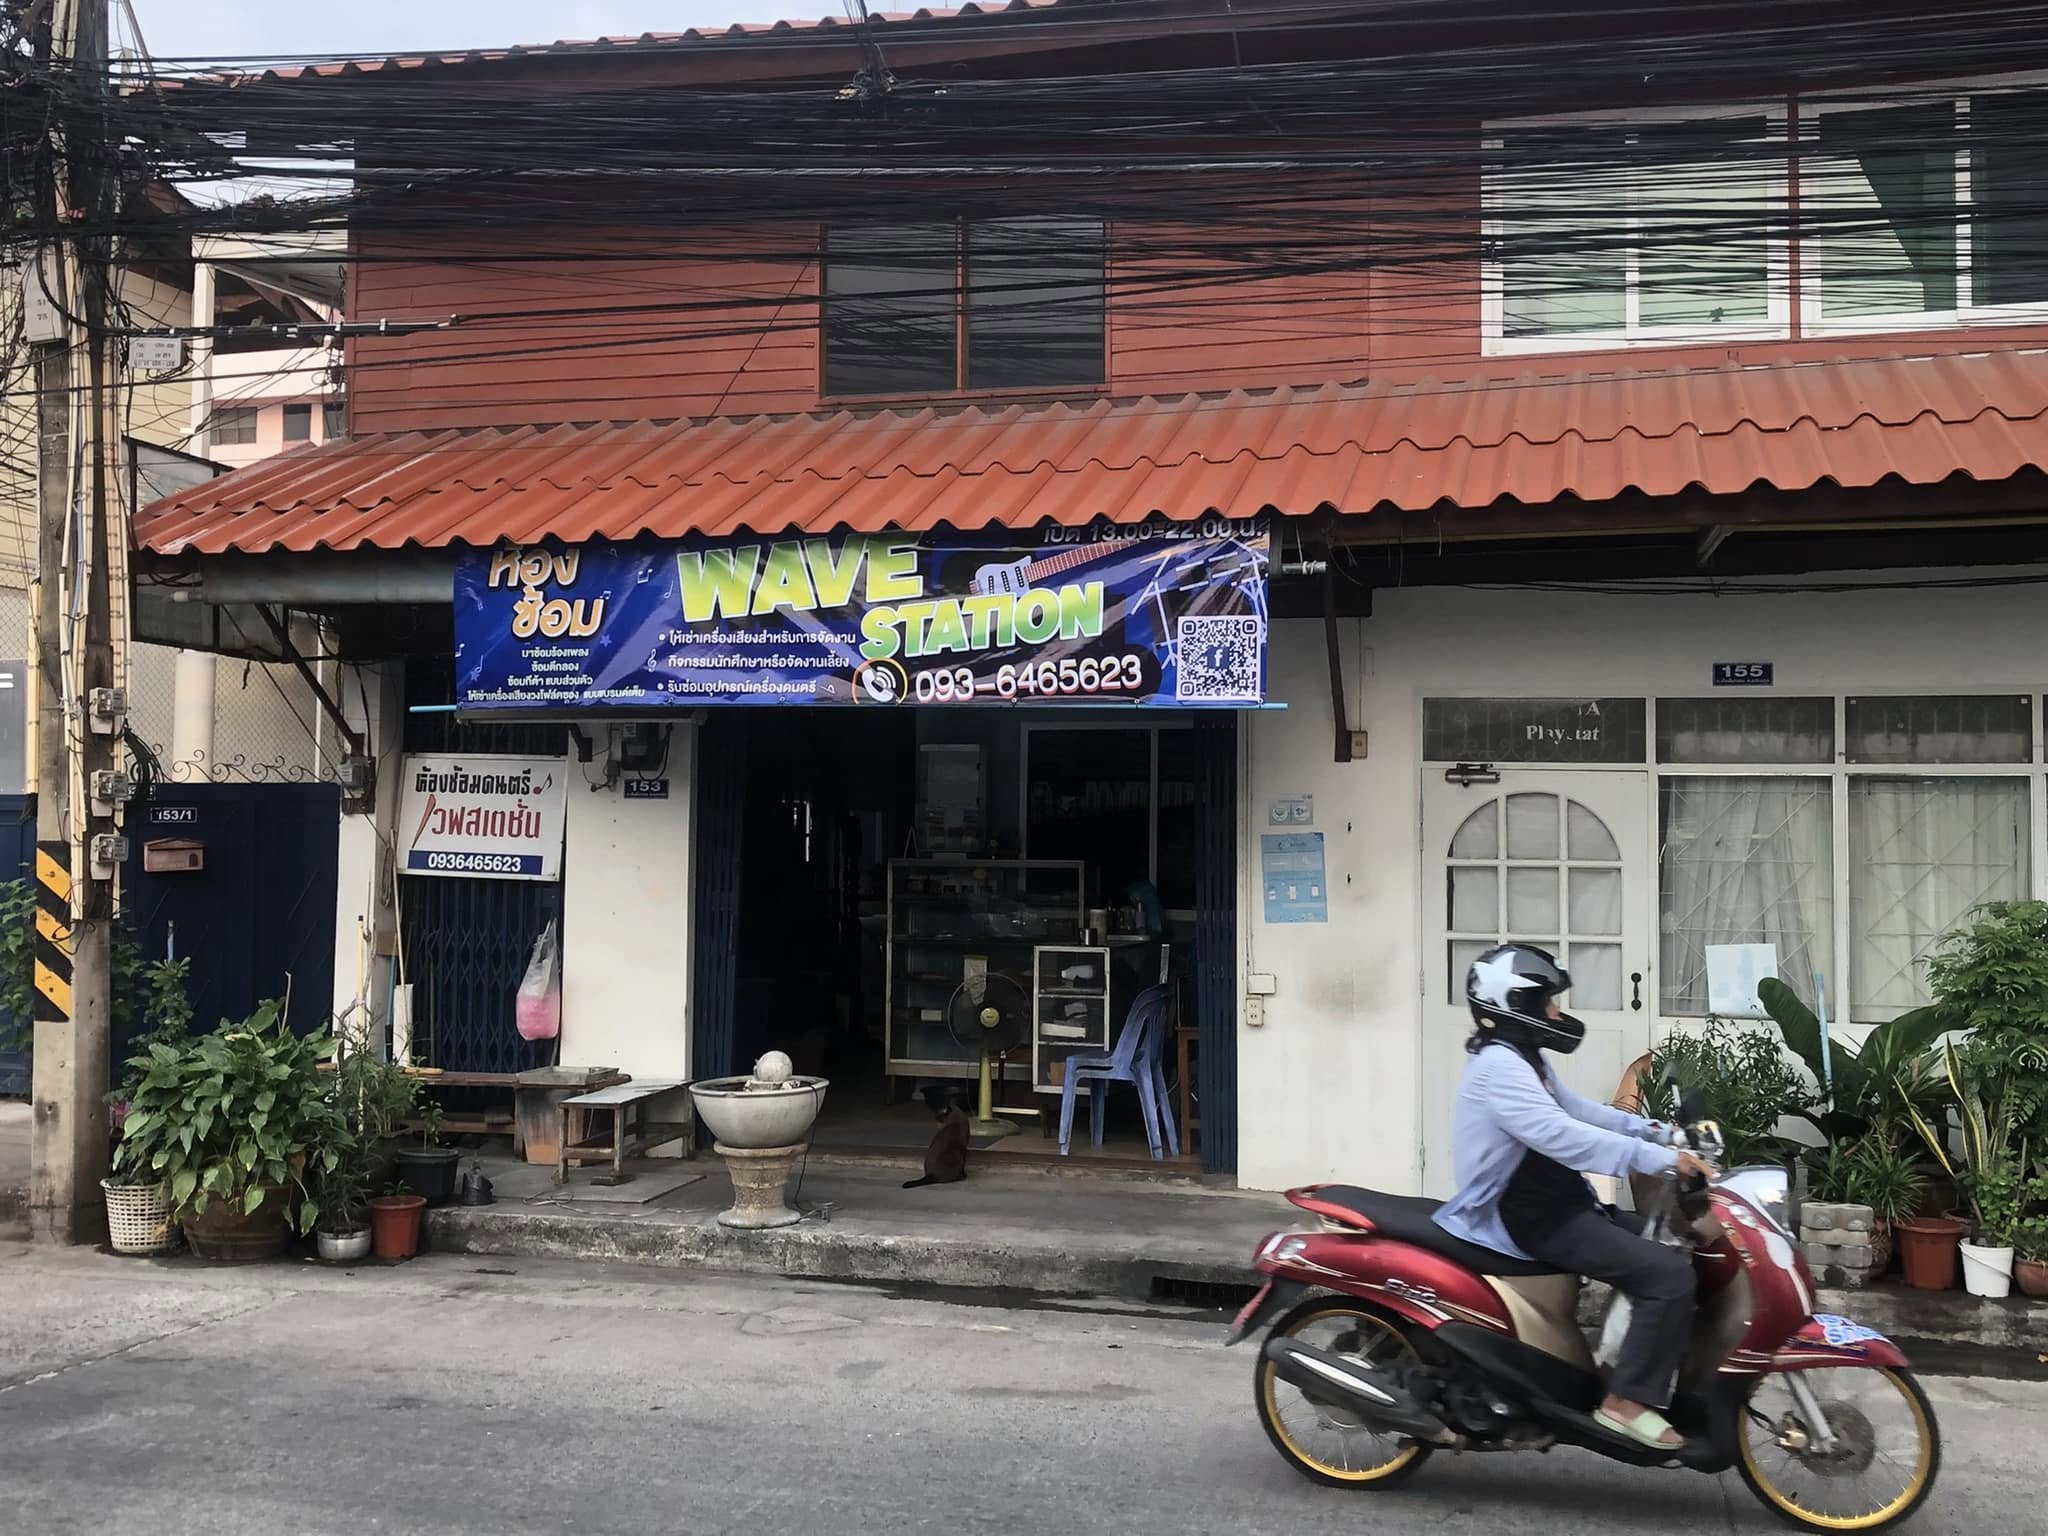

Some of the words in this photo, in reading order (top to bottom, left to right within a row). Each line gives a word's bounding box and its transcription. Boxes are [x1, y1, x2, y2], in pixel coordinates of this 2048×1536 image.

[677, 530, 924, 623] WAVE
[512, 586, 605, 638] ซ้อม
[858, 581, 1104, 661] STATION
[915, 654, 1142, 702] 093-6465623
[1722, 664, 1764, 678] 155
[415, 765, 532, 795] ห้องซ้อมดนตรี
[630, 780, 661, 792] 153
[156, 810, 192, 820] 153/1
[428, 853, 522, 873] 0936465623
